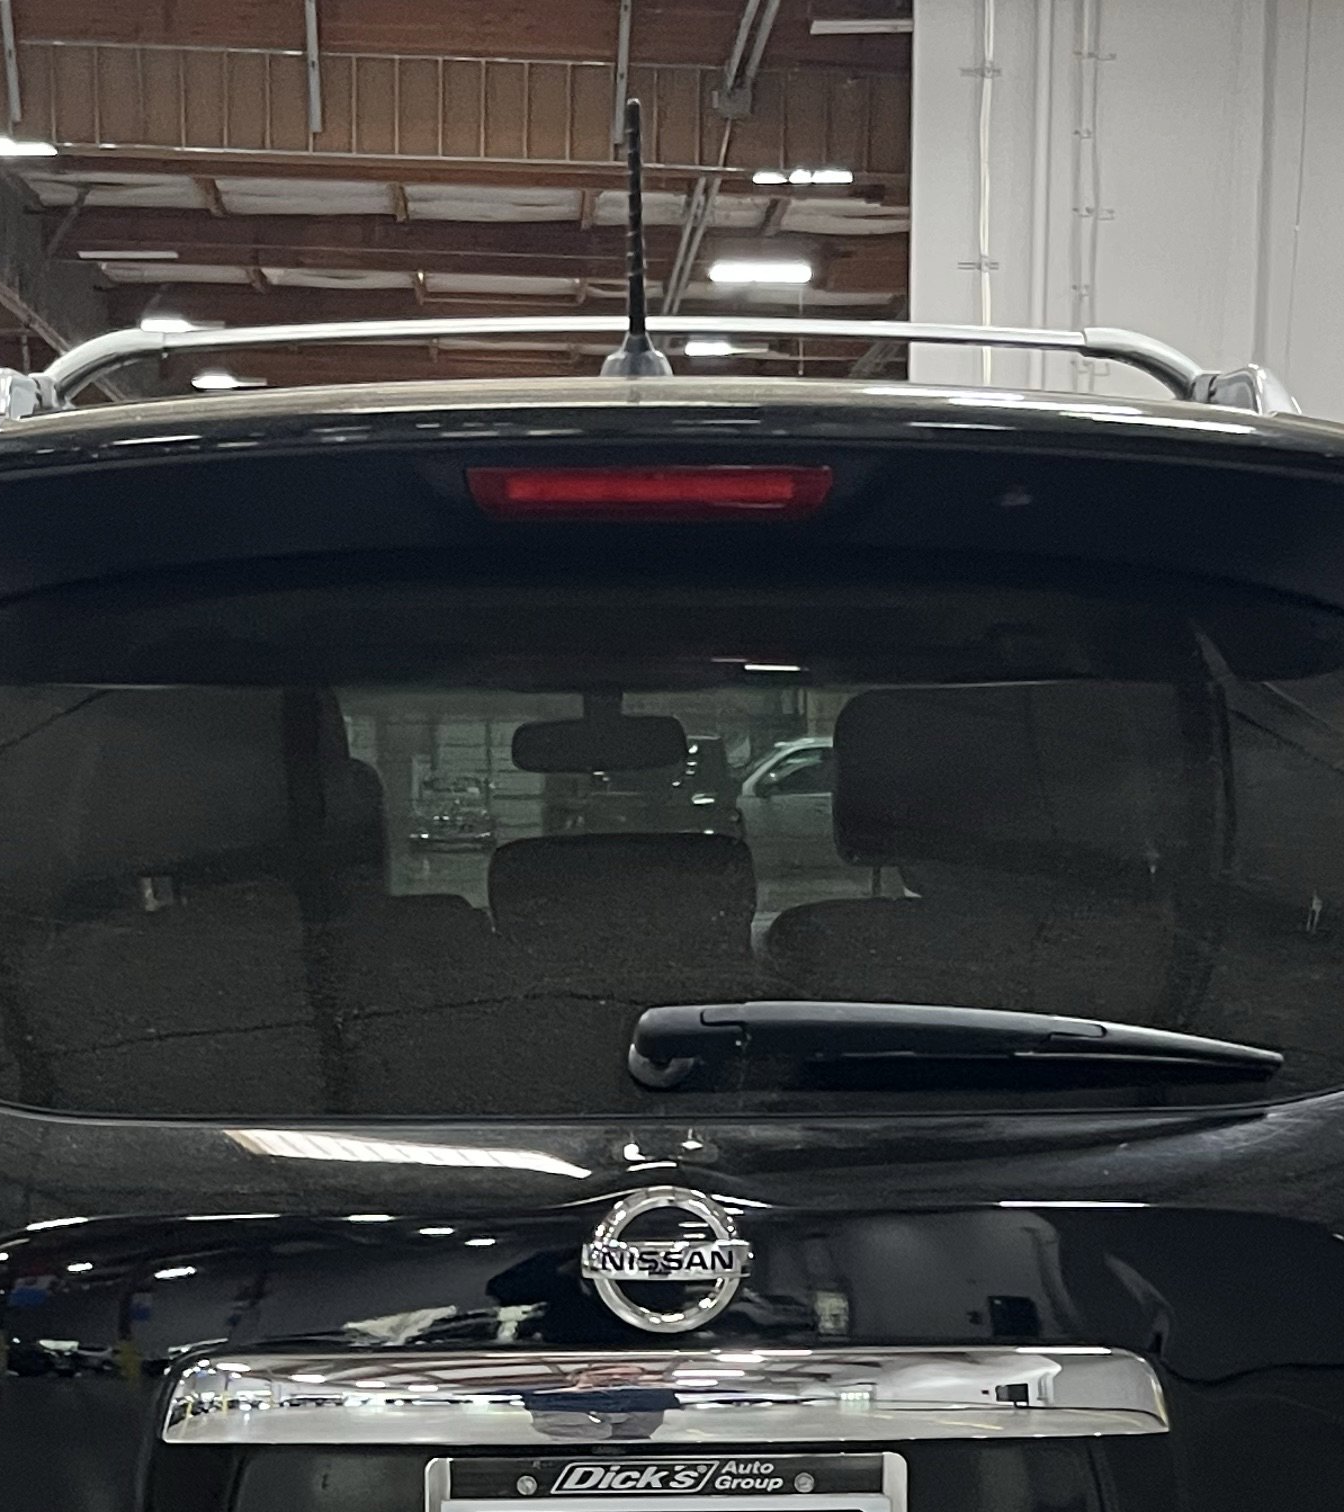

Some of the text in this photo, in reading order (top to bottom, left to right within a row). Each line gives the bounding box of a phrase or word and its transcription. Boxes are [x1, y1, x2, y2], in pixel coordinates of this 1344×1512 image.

[601, 1251, 734, 1271] NISSAN
[722, 1460, 774, 1475] Auto
[714, 1475, 784, 1493] Group
